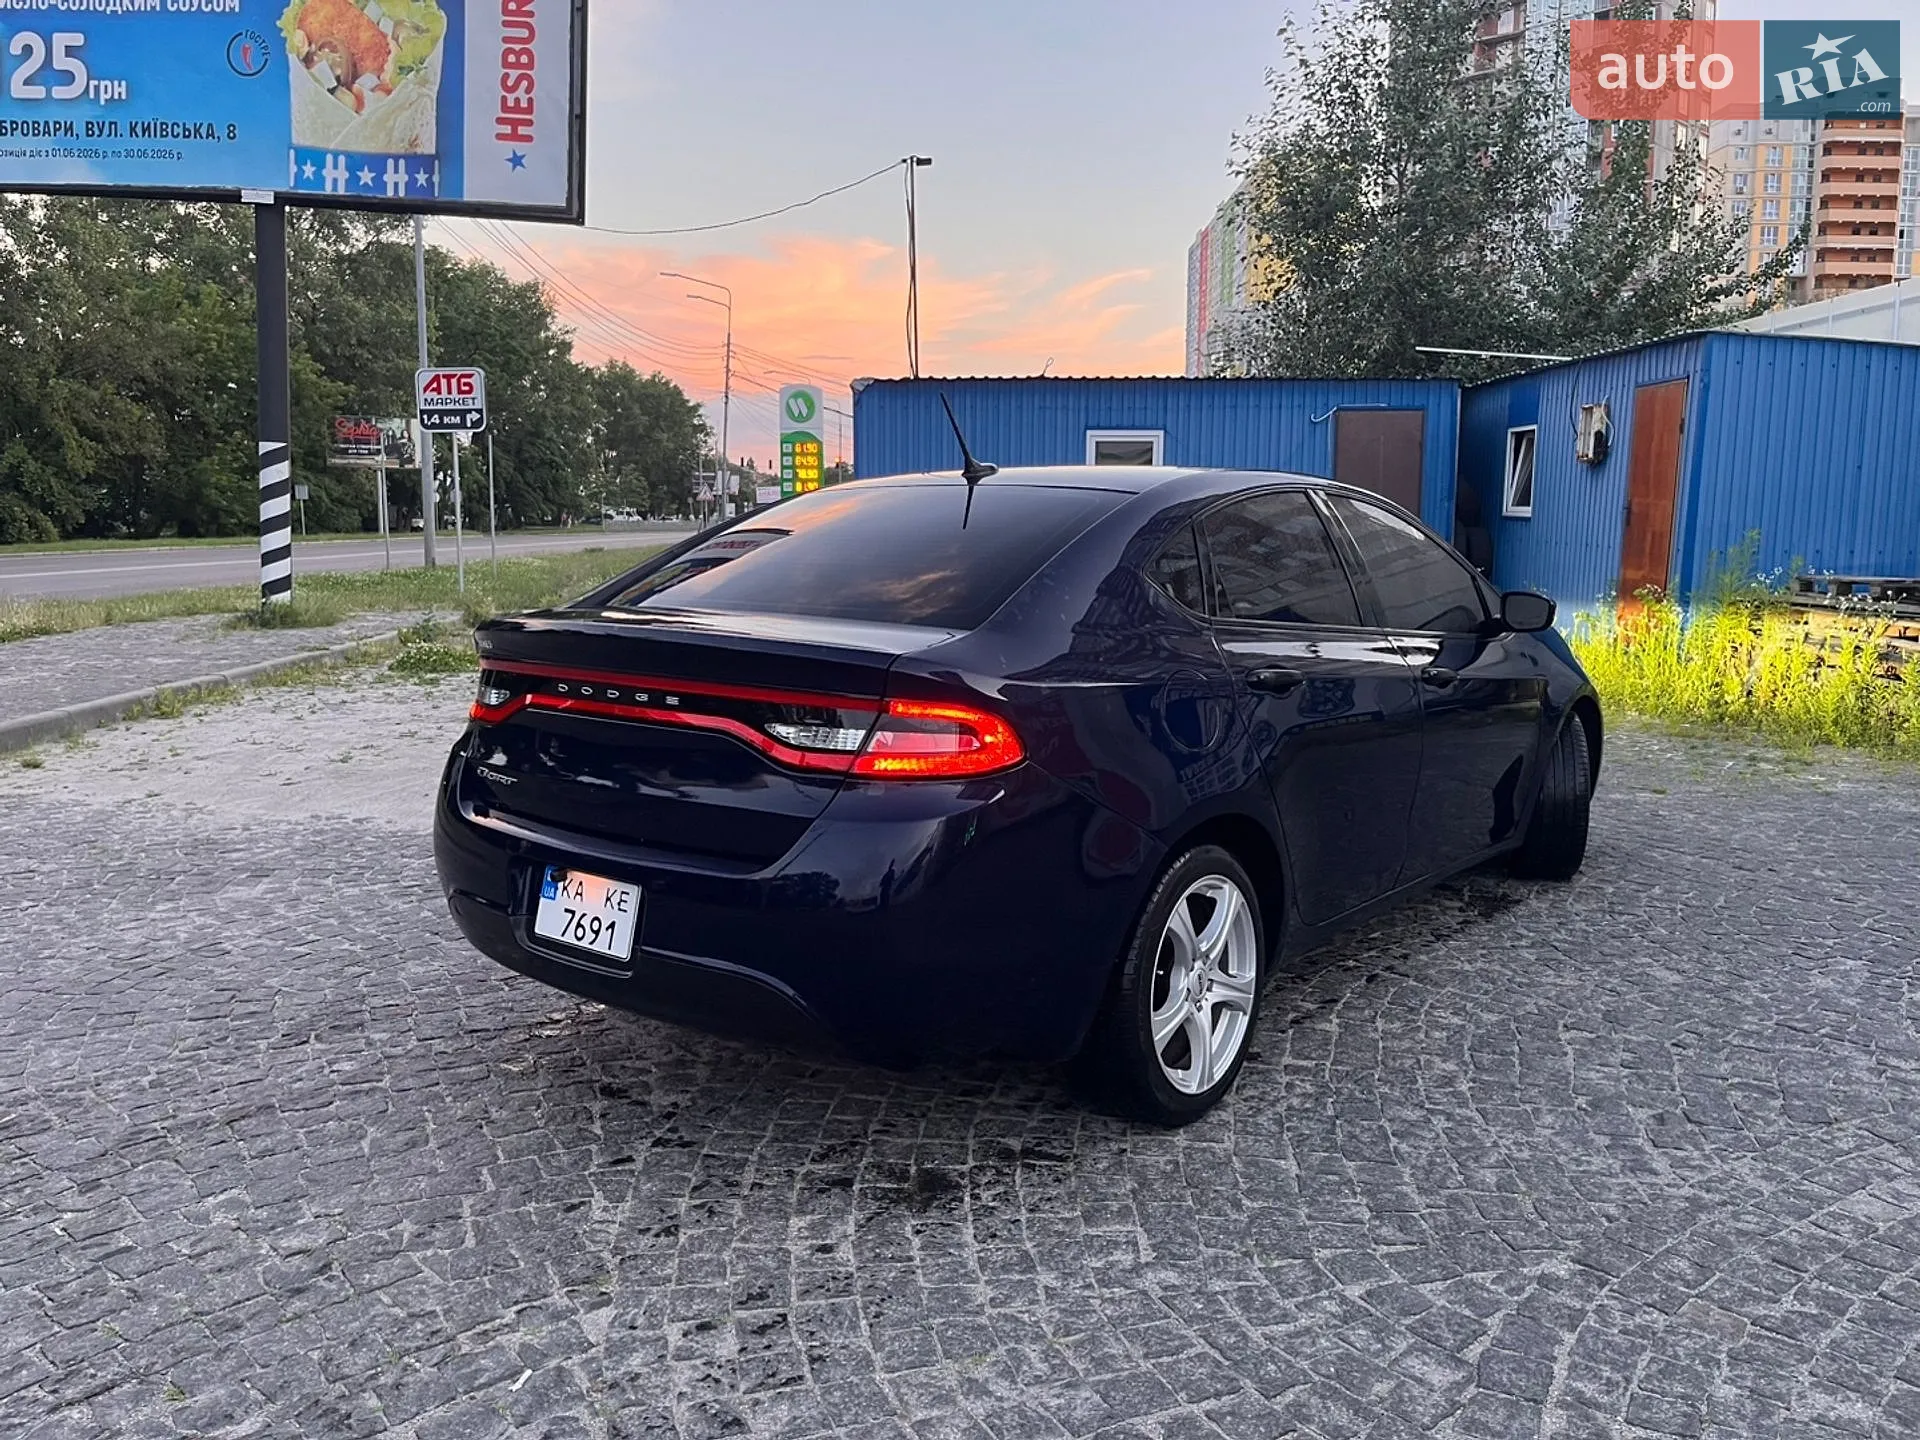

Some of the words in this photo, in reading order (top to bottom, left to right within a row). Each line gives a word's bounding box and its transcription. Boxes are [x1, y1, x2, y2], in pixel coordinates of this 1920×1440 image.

[167, 0, 240, 12] СОУСОМ
[89, 79, 127, 105] грн
[0, 119, 80, 141] БРОВАРИ,
[85, 120, 123, 139] ВУЛ.
[129, 118, 221, 143] КИЇВСЬКА,
[226, 123, 238, 140] 8
[423, 373, 476, 395] АТБ
[424, 397, 478, 407] МАРКЕТ
[422, 414, 440, 426] 1,4
[557, 683, 680, 705] DODGE
[543, 887, 555, 899] UA
[561, 879, 584, 902] KA
[604, 887, 630, 913] KE
[561, 908, 616, 951] 7691
